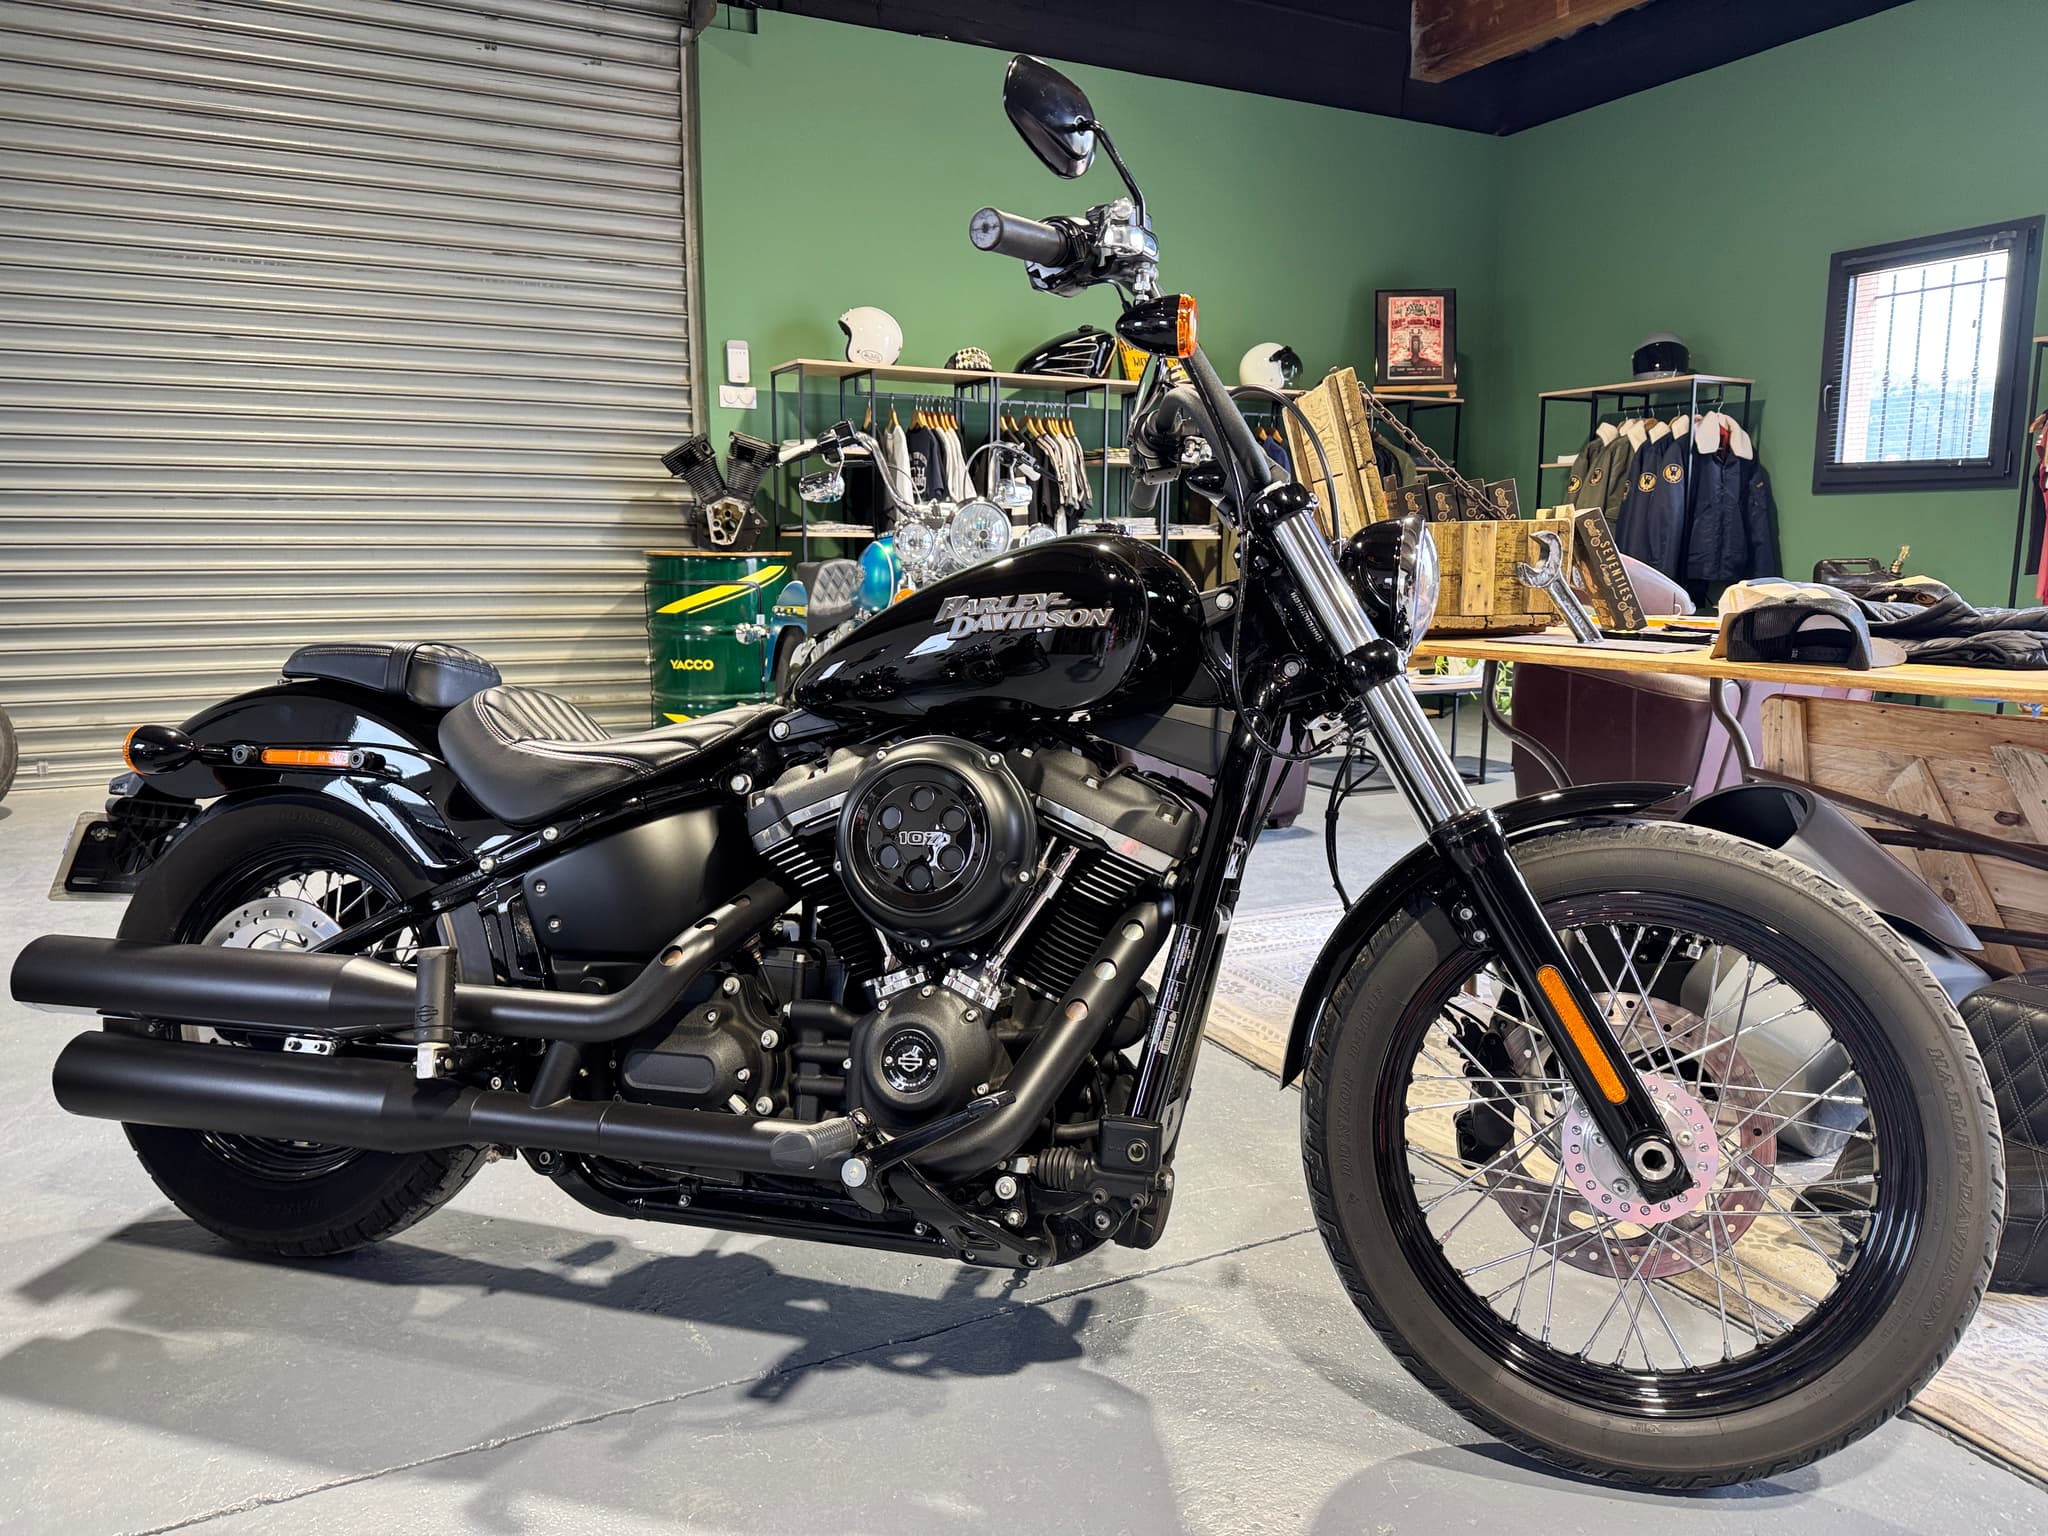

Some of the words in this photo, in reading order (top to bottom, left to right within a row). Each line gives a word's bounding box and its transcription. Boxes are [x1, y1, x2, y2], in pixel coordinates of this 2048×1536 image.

[1600, 540, 1633, 602] SEVENTIES
[946, 607, 1115, 640] DAVIDSON
[669, 658, 714, 671] YACCO
[898, 830, 944, 846] 107
